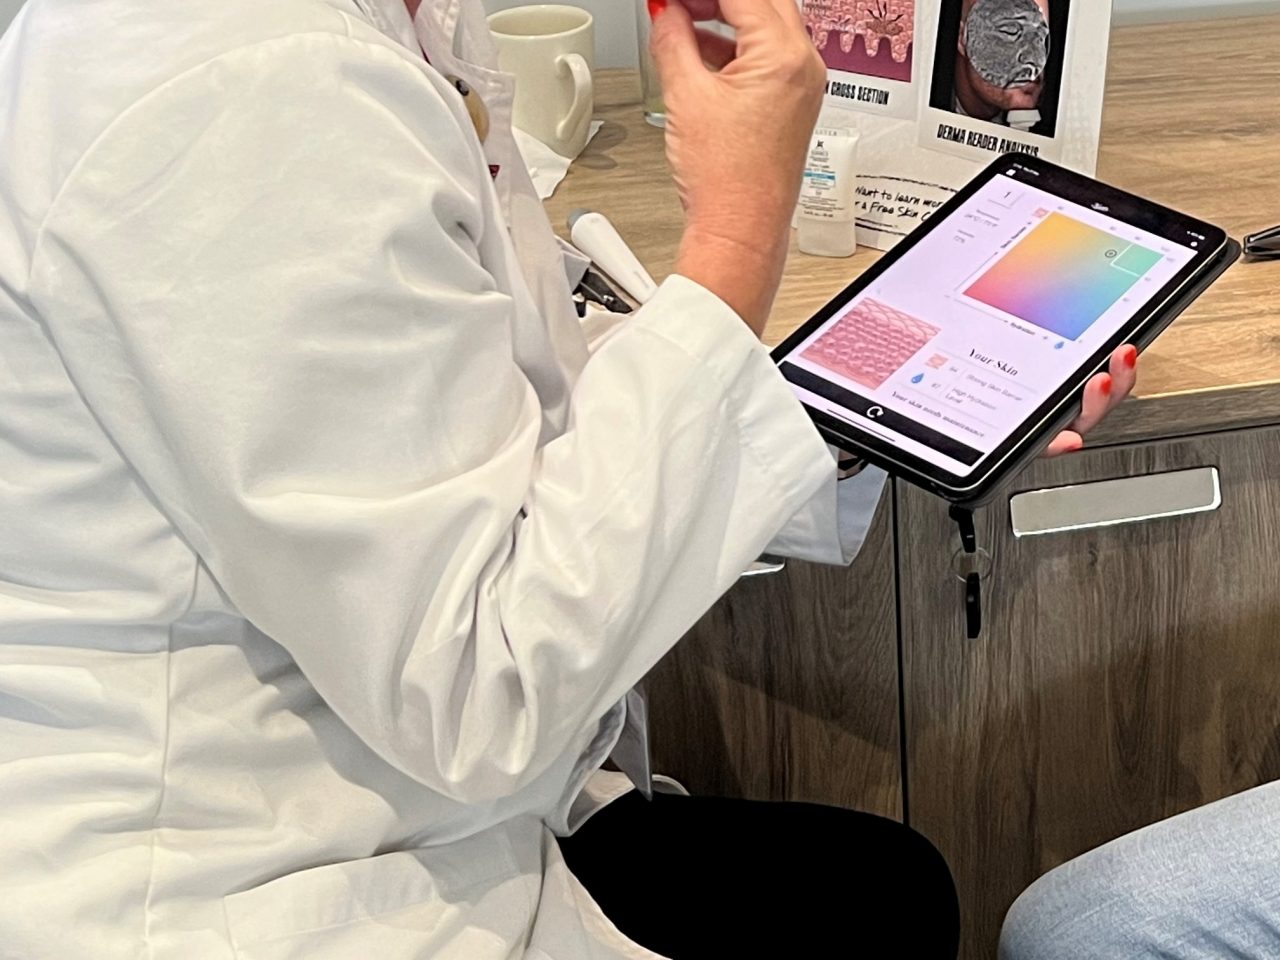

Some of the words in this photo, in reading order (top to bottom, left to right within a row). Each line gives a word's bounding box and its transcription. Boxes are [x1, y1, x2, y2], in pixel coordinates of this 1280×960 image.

[831, 81, 855, 99] CROSS
[857, 85, 889, 106] SECTION
[936, 124, 966, 144] DERMA
[967, 130, 998, 152] READER
[869, 201, 894, 214] Free
[897, 206, 918, 218] Skin
[881, 191, 892, 200] to
[894, 192, 920, 204] learn
[923, 200, 944, 208] mor
[969, 348, 993, 365] Your
[993, 360, 1018, 376] Skin
